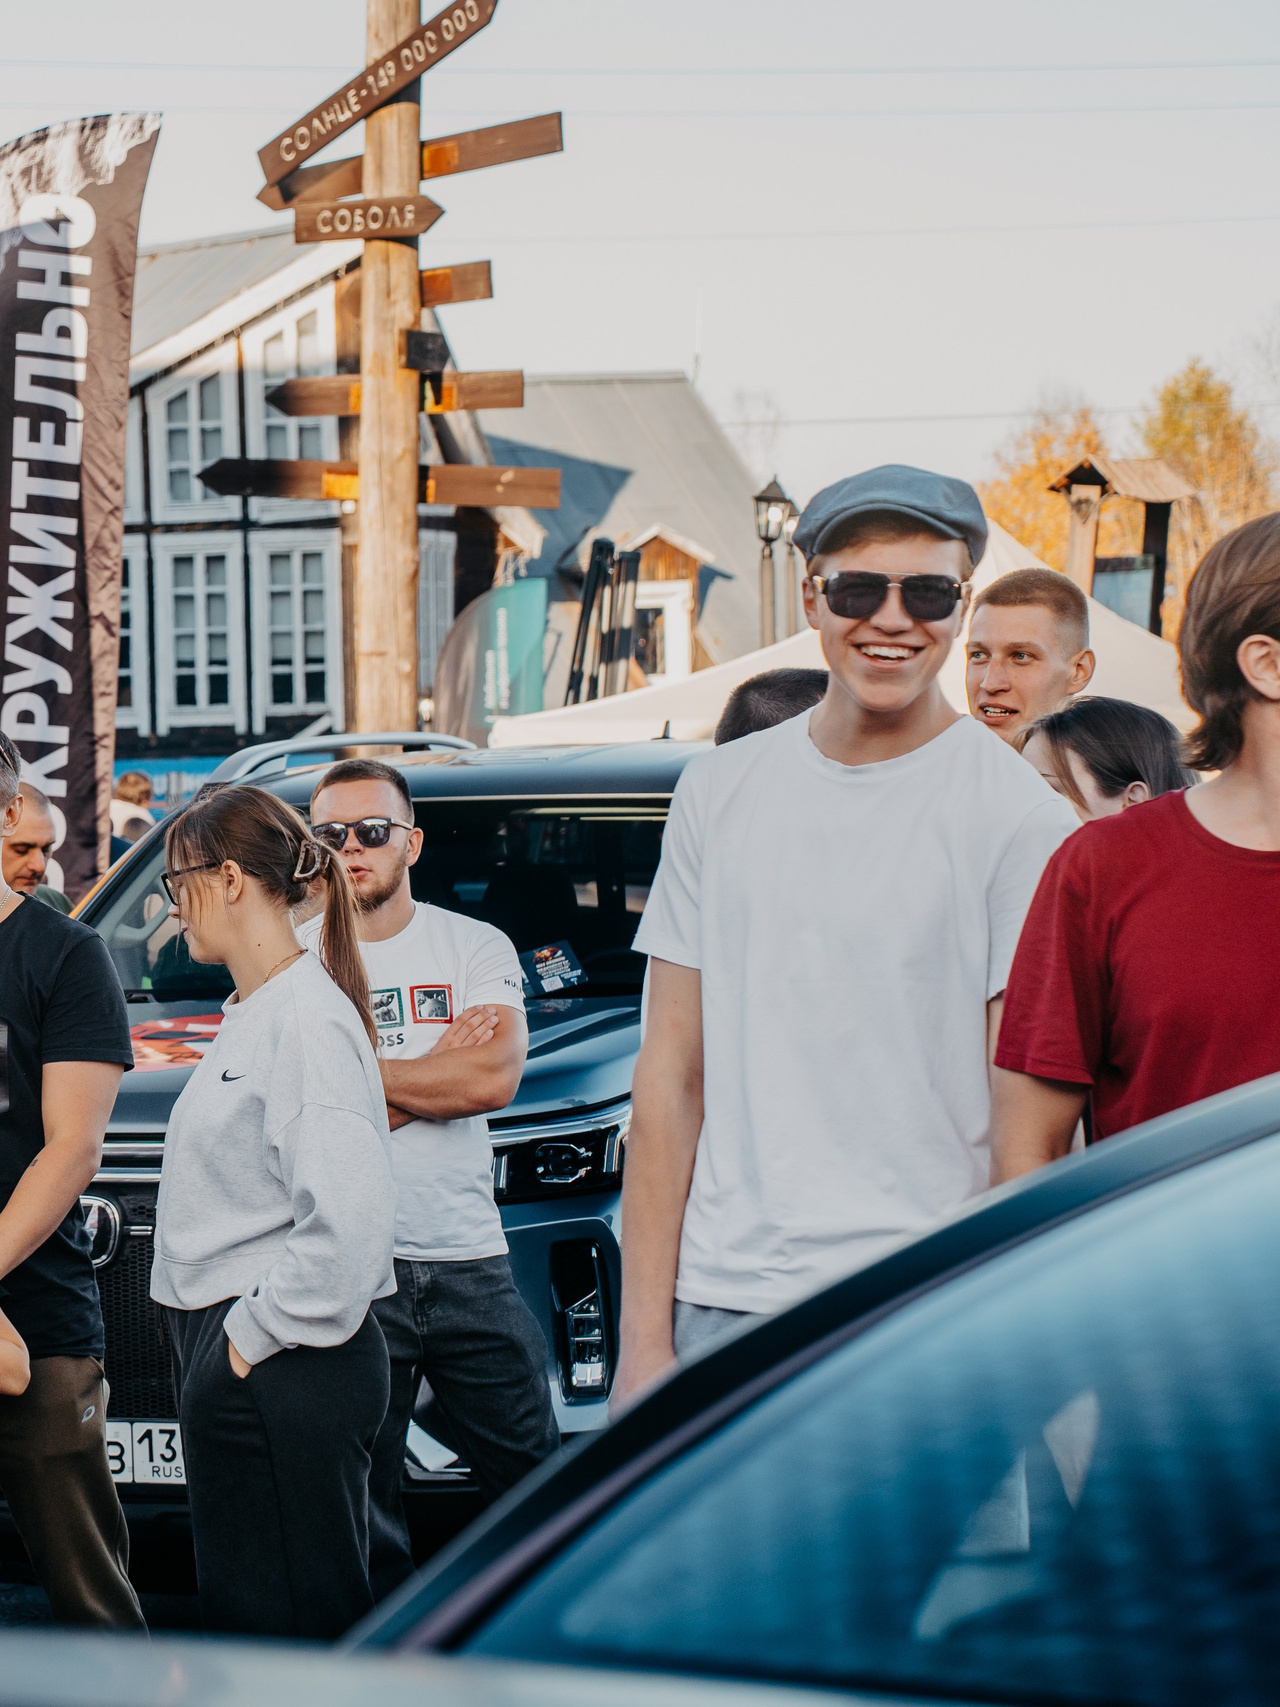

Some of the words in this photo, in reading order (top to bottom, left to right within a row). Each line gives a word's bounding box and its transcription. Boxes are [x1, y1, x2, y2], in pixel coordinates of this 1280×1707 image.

[316, 204, 415, 233] СОБОЛЯ
[136, 1428, 180, 1463] 13
[151, 1465, 184, 1479] RUS
